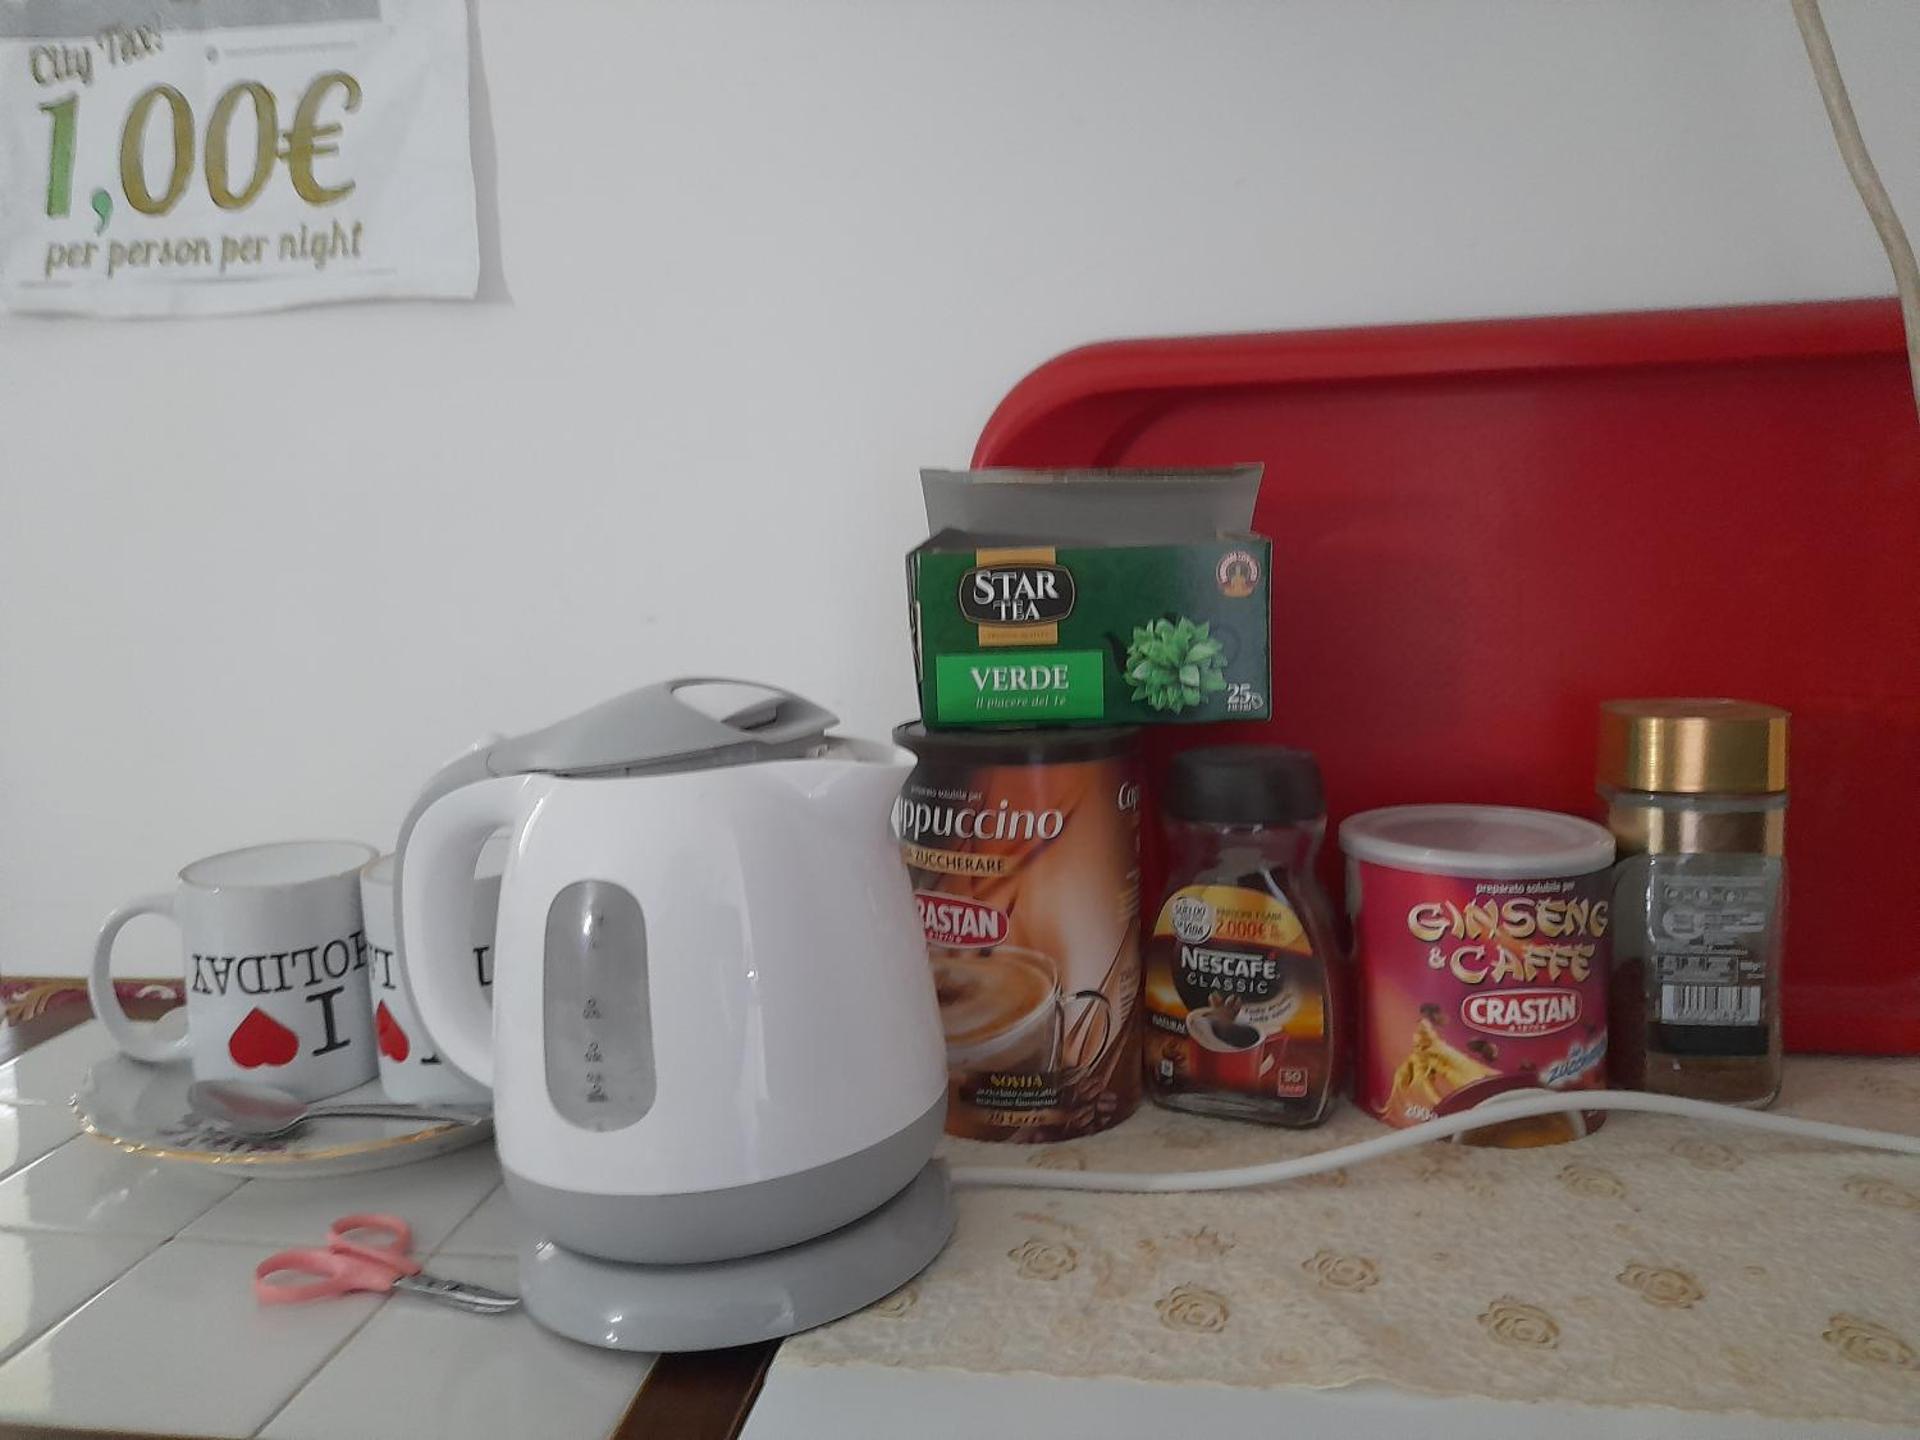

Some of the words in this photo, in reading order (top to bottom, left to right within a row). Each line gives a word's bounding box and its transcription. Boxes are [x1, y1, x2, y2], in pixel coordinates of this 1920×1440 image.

[29, 42, 94, 86] City
[38, 71, 363, 235] 1,00€
[45, 240, 99, 280] per
[107, 236, 211, 279] person
[220, 233, 268, 277] per
[278, 218, 362, 270] night
[973, 570, 1059, 605] STAR
[993, 600, 1041, 621] TEA
[970, 665, 1070, 692] VERDE
[1227, 683, 1251, 704] 25
[901, 799, 1064, 841] ppuccino
[915, 897, 999, 939] RASTAN
[1407, 897, 1609, 942] GINSENG
[192, 930, 365, 996] HOLIDAY
[1429, 946, 1448, 970] &
[1187, 971, 1269, 995] CLASSIC
[306, 985, 351, 1057] I
[1469, 994, 1577, 1027] CRASTAN
